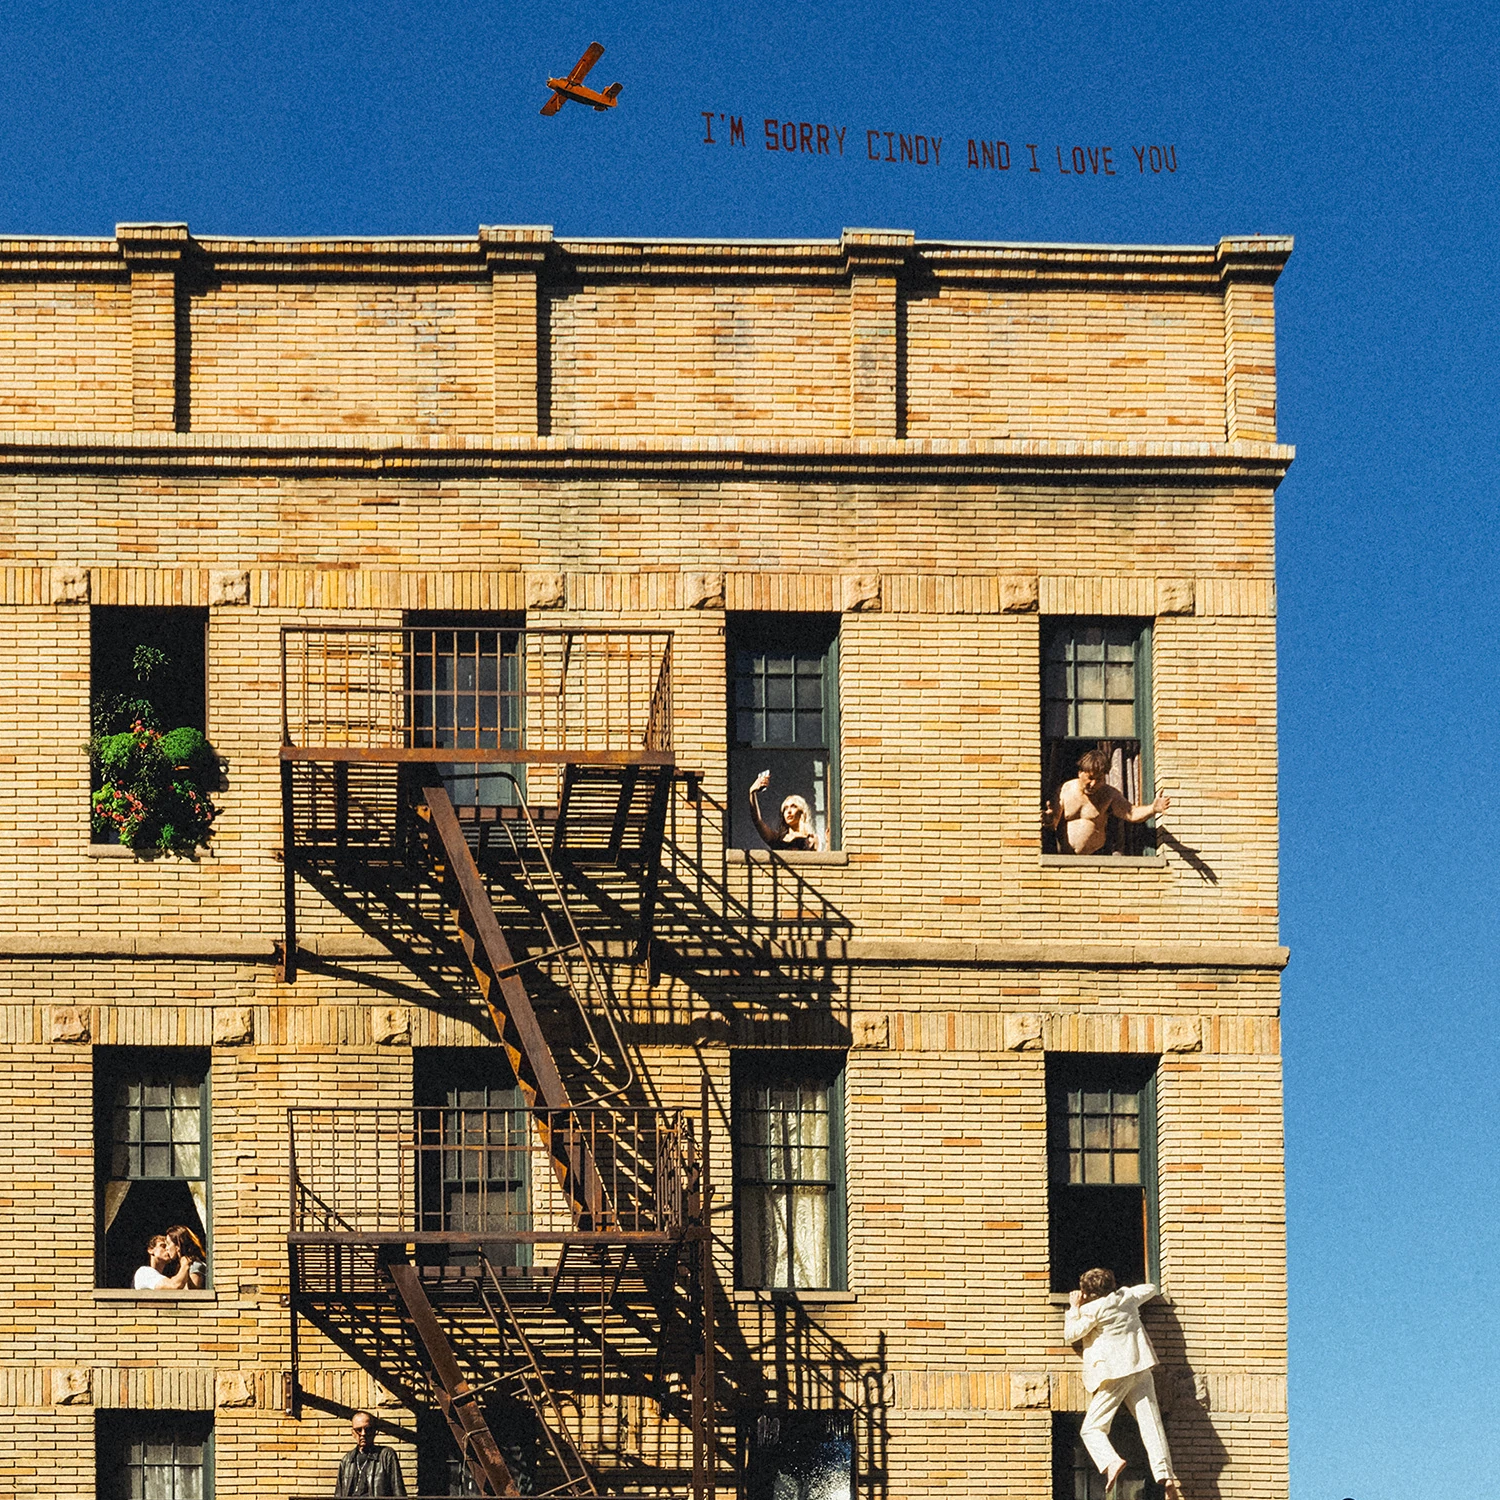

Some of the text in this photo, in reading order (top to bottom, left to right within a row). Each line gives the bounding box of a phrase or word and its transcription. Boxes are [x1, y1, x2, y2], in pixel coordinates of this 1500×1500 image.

[701, 112, 1177, 175] I'M SORRY CINDY AND I LOVE YOU
